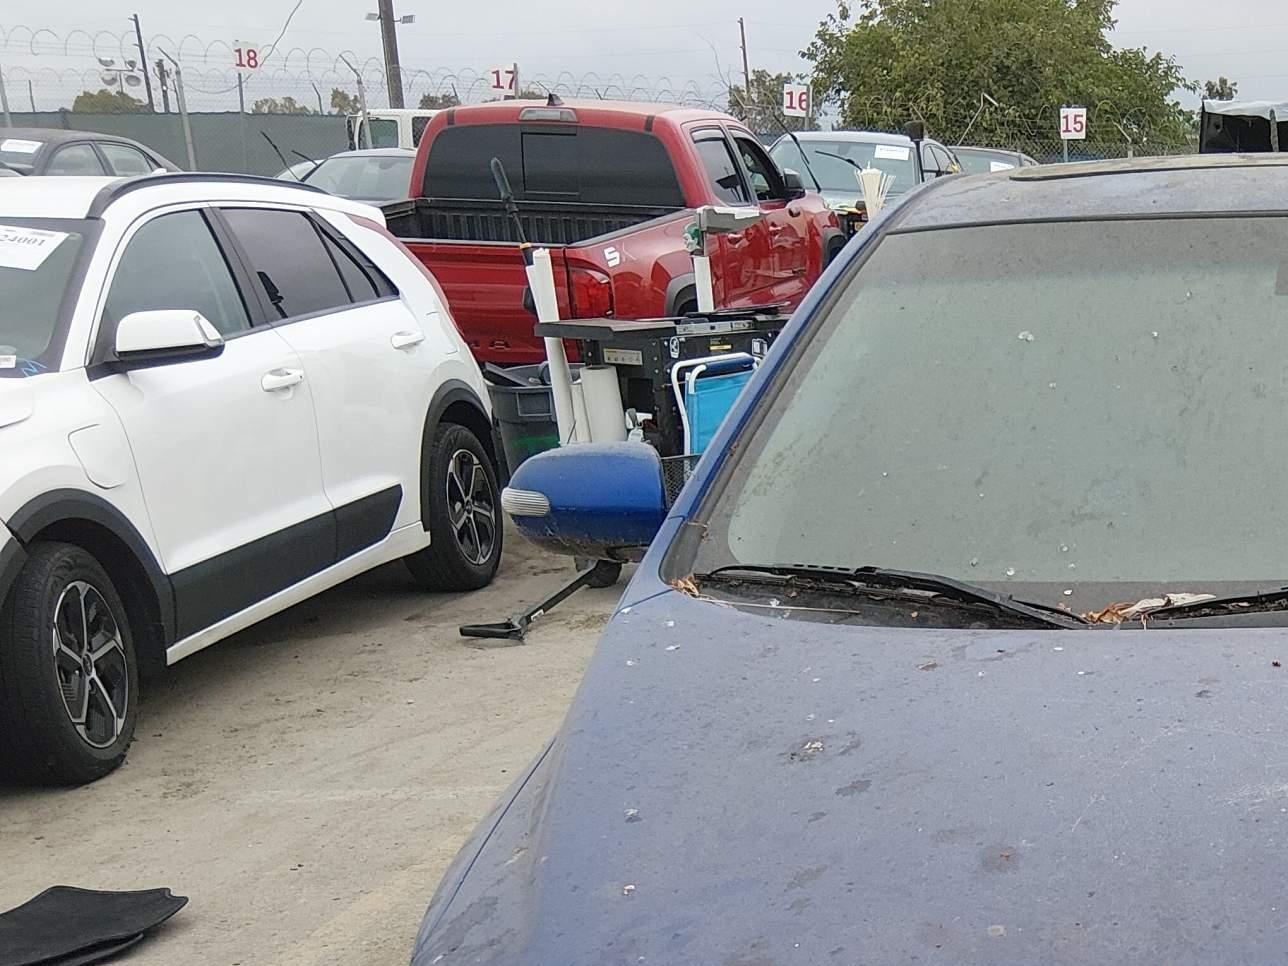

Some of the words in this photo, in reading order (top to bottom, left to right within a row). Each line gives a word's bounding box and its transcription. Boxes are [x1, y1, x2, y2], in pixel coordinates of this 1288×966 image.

[234, 48, 259, 68] 18
[491, 69, 515, 90] 17
[785, 90, 808, 112] 16
[1062, 114, 1084, 134] 15
